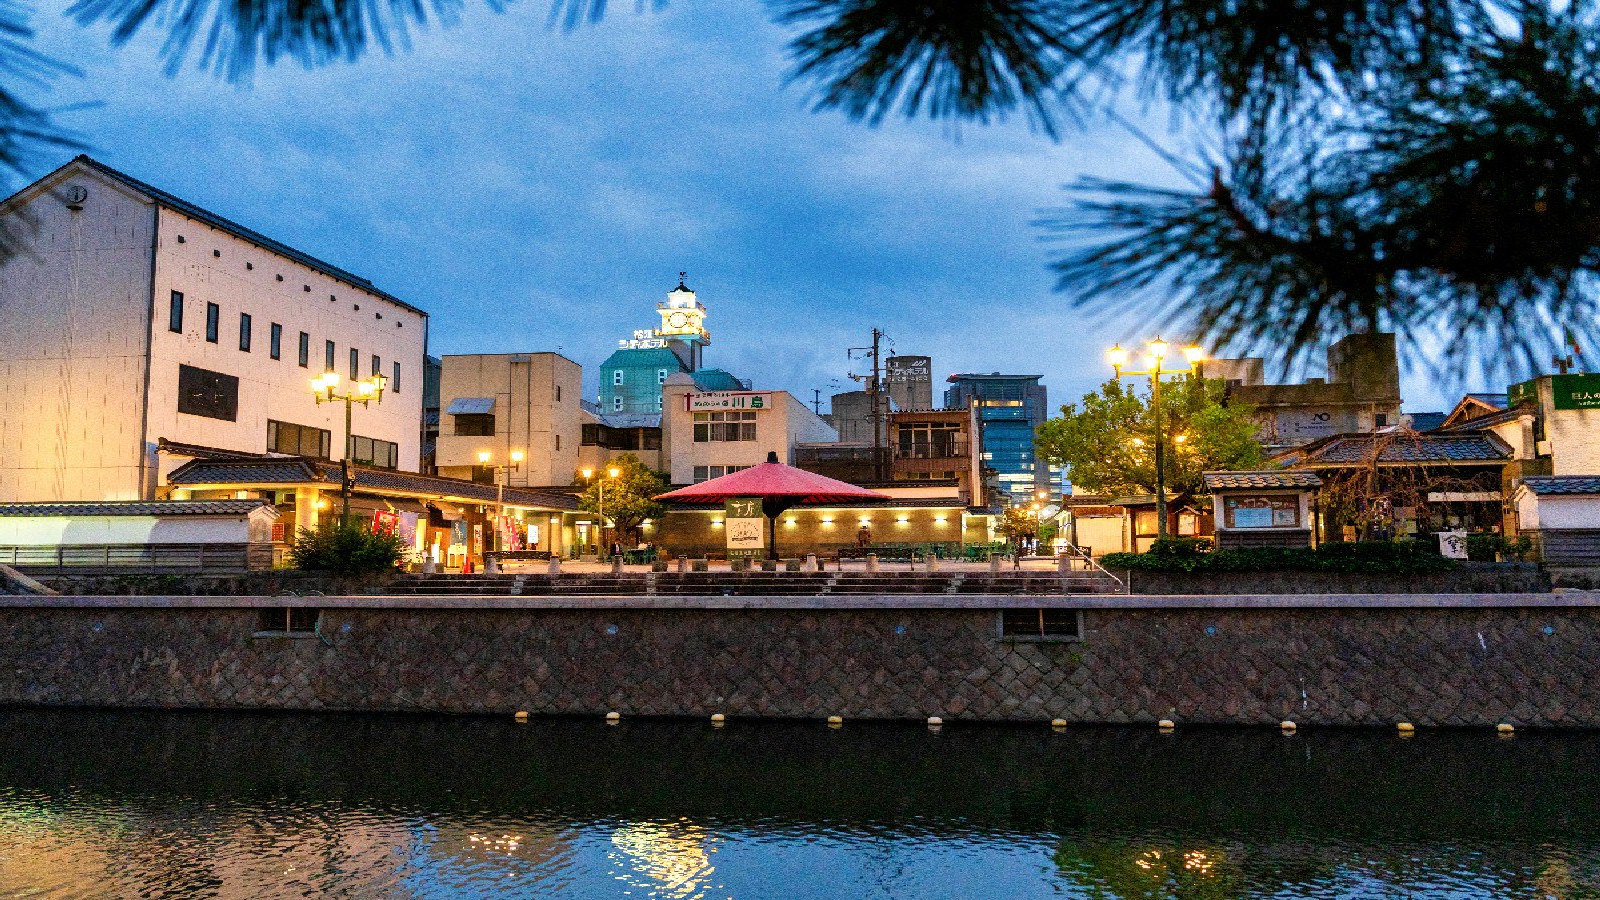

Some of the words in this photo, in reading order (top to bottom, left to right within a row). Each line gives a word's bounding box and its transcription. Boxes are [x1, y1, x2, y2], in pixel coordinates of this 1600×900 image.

[633, 329, 653, 339] 松江
[618, 339, 668, 349] シティホテル
[731, 396, 764, 409] 川島
